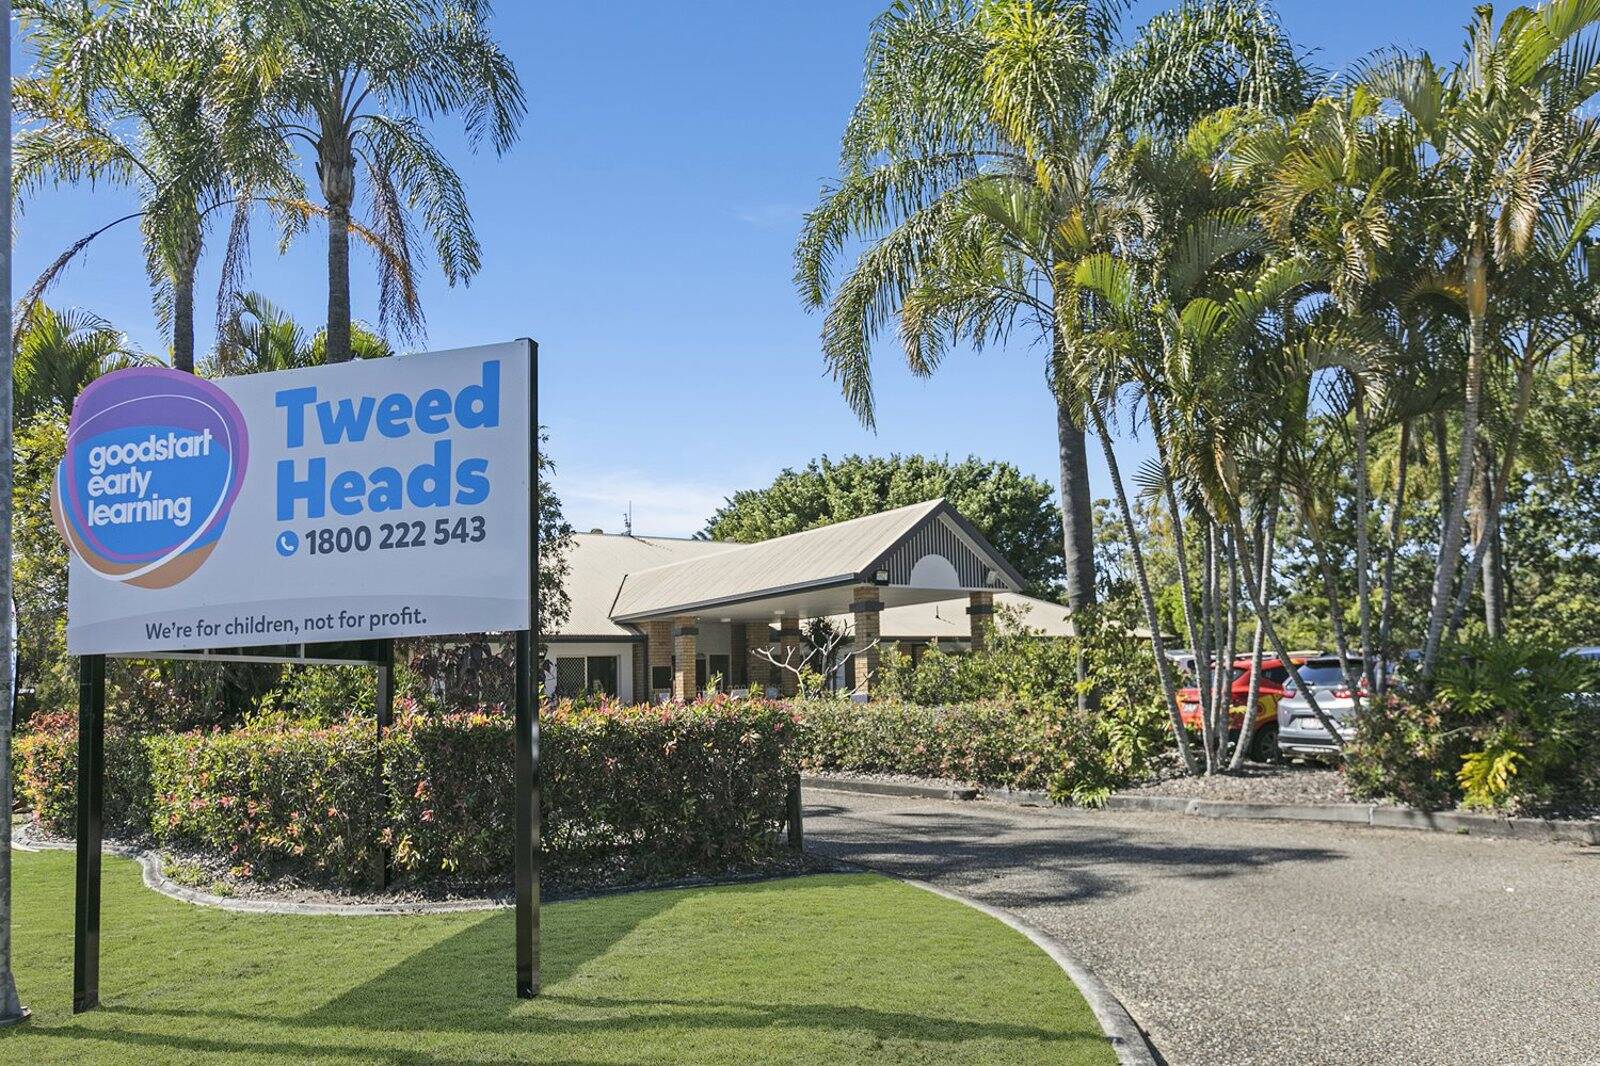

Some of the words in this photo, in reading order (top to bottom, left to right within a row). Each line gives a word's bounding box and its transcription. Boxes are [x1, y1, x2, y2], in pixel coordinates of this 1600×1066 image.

[275, 360, 500, 448] Tweed
[88, 428, 212, 475] goodstart
[87, 465, 151, 497] early
[276, 440, 491, 521] Heads
[88, 494, 192, 527] learning
[305, 525, 372, 555] 1800
[378, 521, 426, 550] 222
[433, 516, 487, 545] 543
[196, 619, 222, 637] for
[225, 612, 300, 636] children,
[304, 614, 335, 631] not
[338, 610, 366, 628] for
[369, 606, 428, 632] profit.
